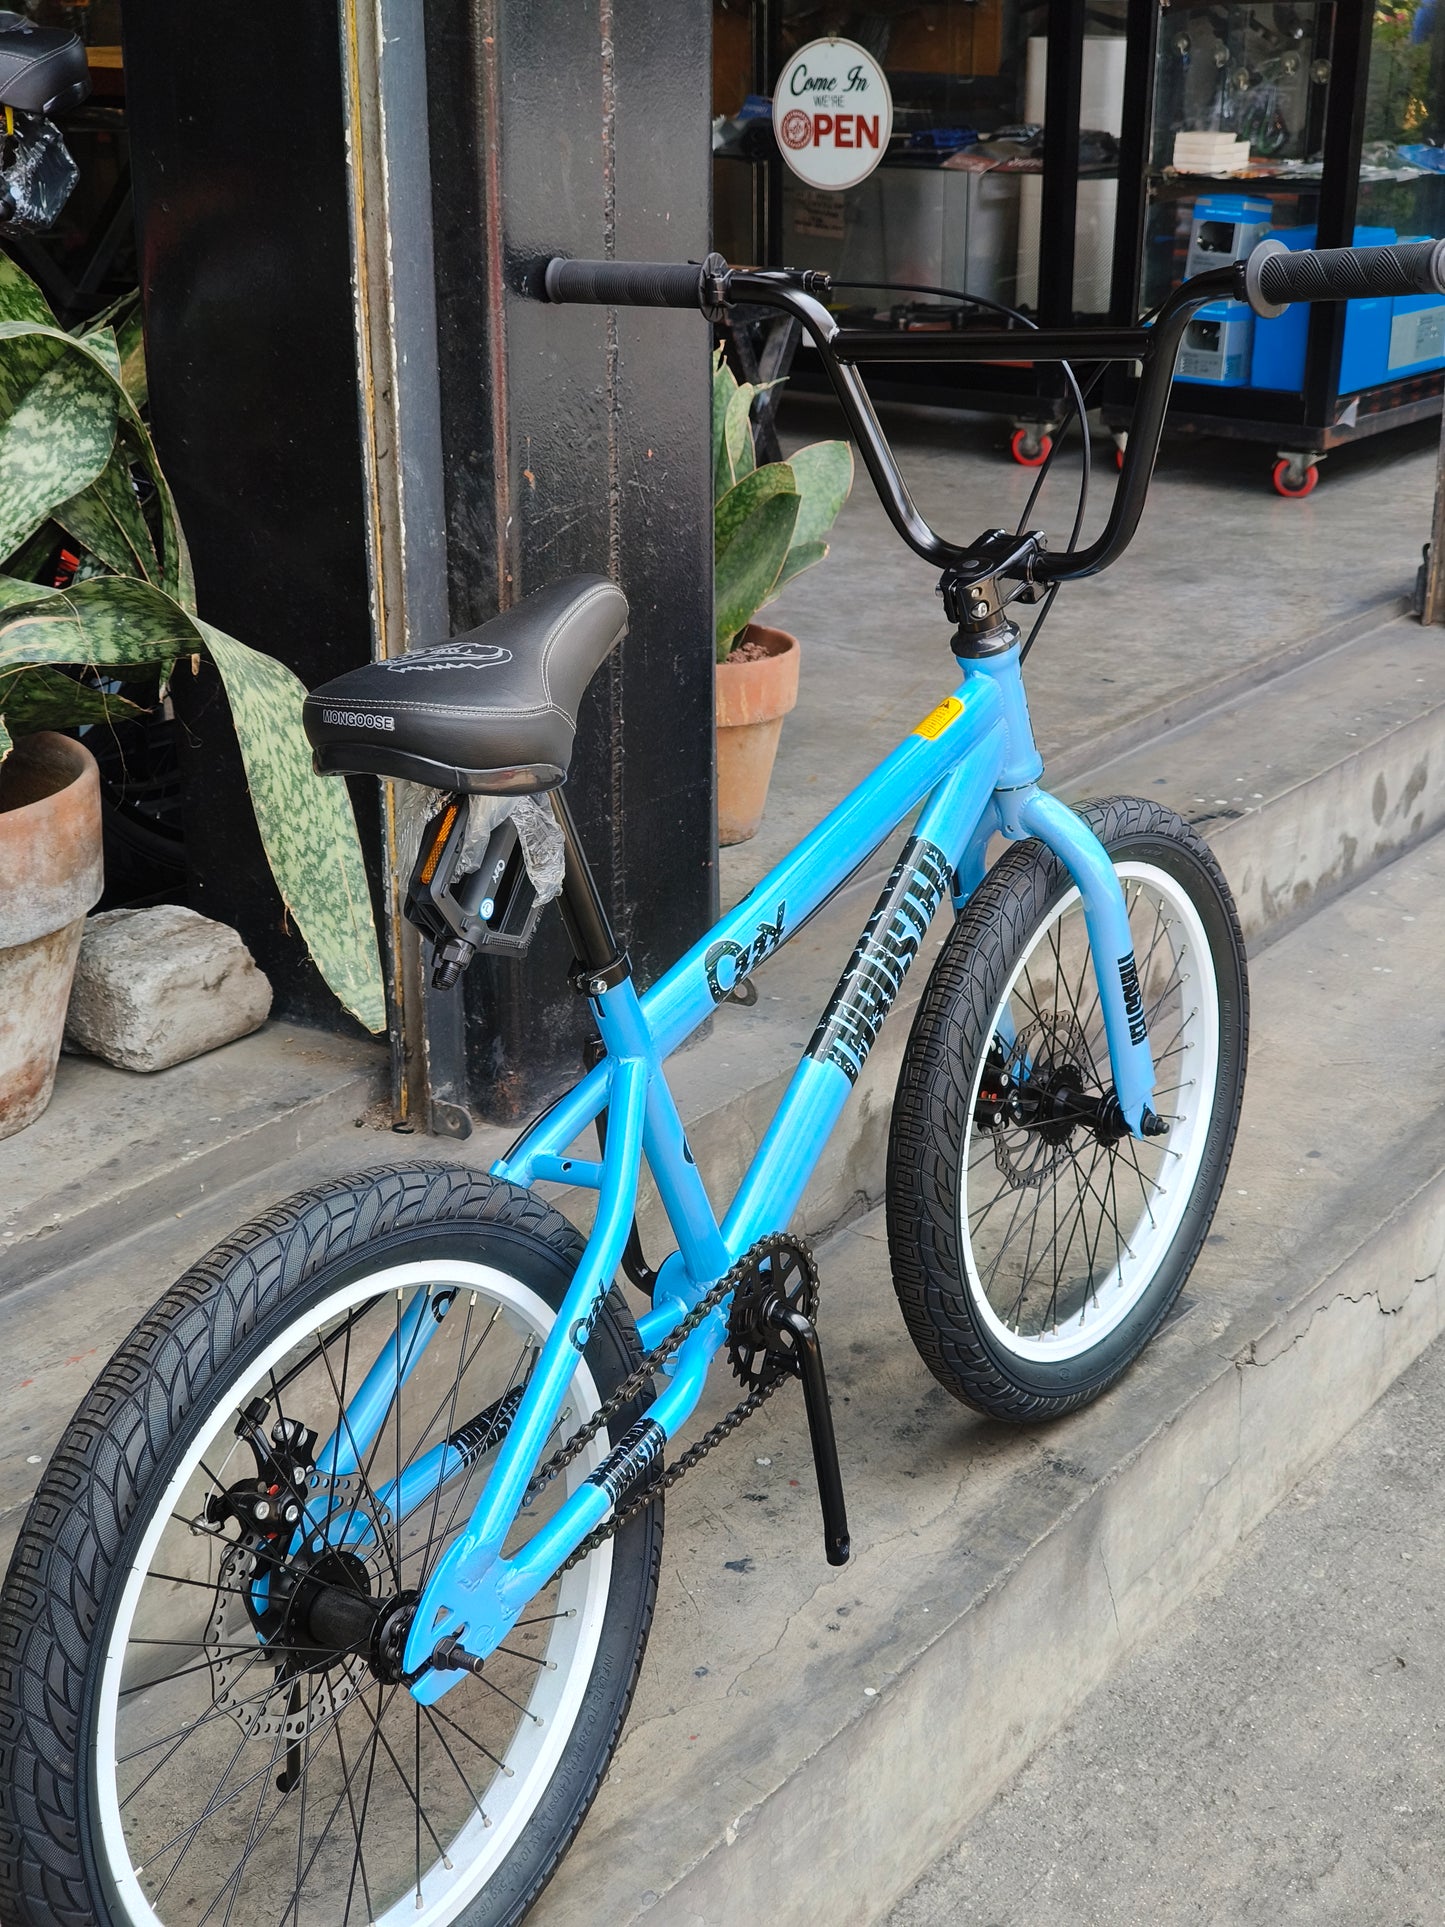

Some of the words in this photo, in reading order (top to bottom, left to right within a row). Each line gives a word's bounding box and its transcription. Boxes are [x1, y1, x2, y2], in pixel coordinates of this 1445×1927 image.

[790, 64, 837, 97] Come
[843, 65, 870, 92] In
[813, 95, 845, 107] WE'RE
[782, 109, 879, 149] OPEN
[322, 709, 395, 731] MONGOOSE
